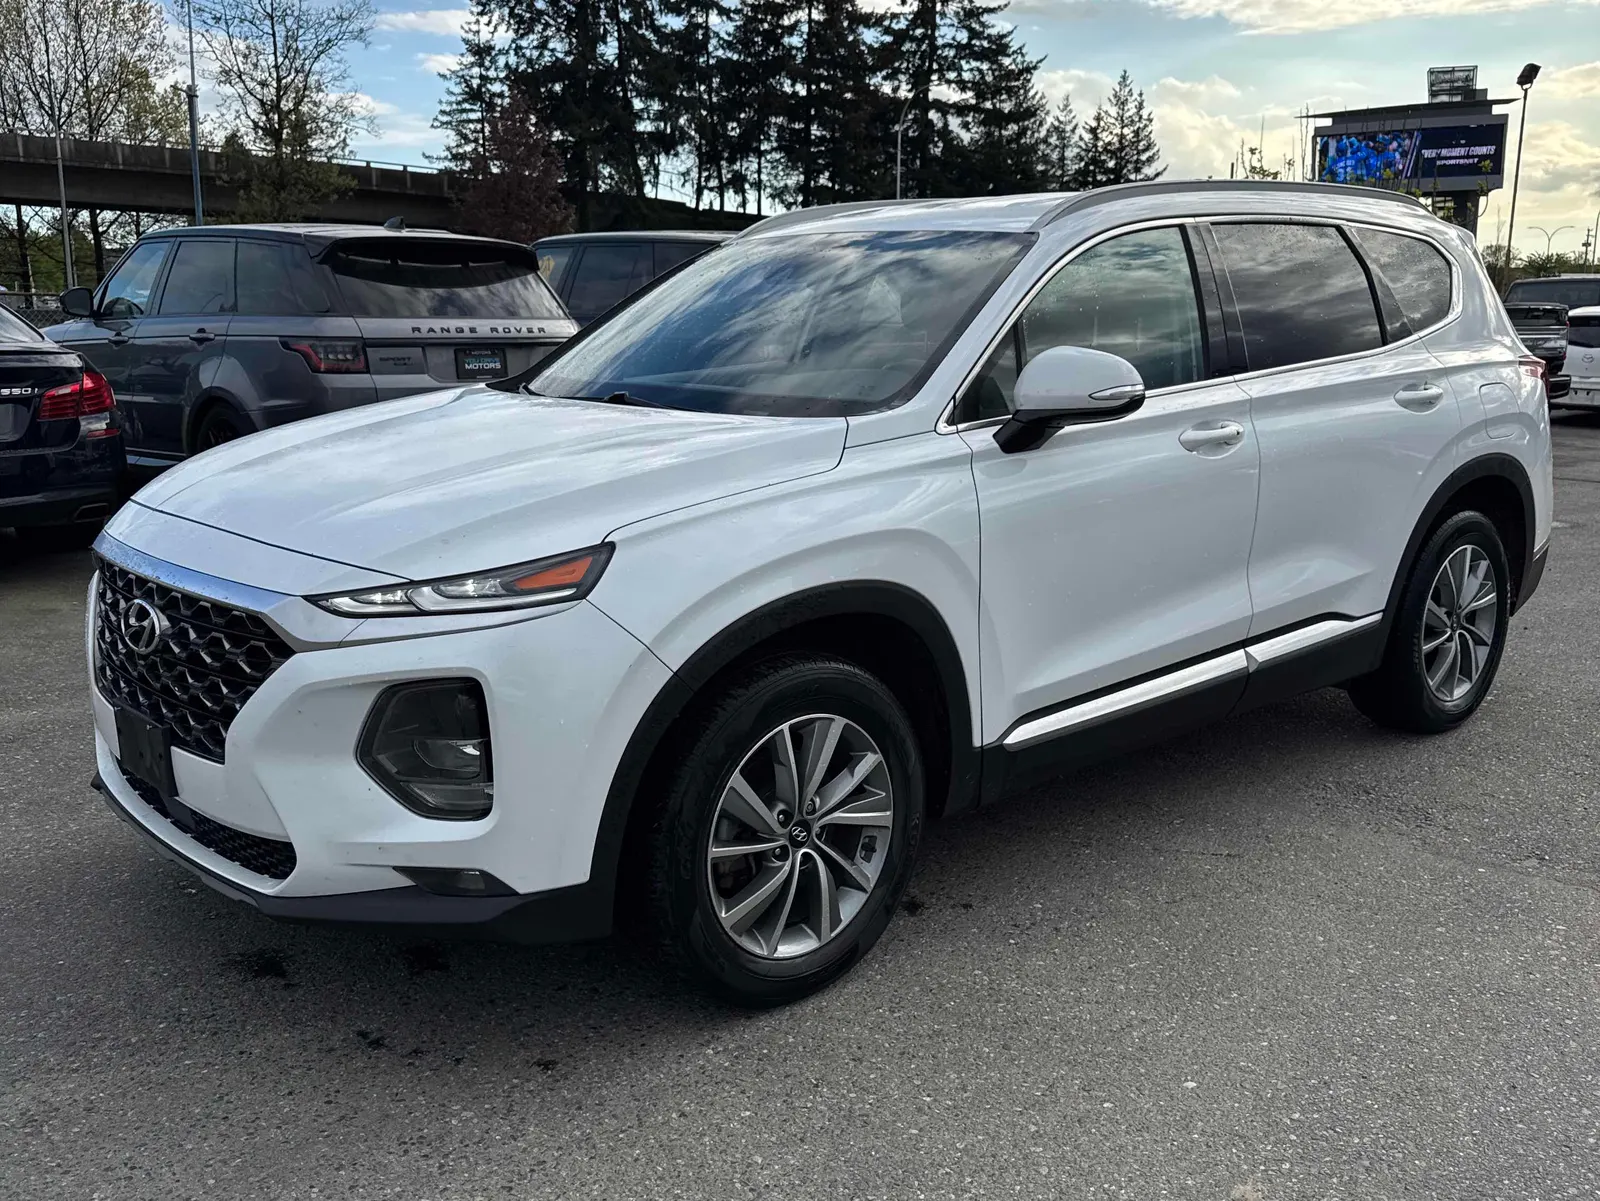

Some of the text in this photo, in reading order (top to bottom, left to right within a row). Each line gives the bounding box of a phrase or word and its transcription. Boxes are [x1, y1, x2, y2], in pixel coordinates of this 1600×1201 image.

[1440, 147, 1469, 157] MOMENT
[1468, 145, 1496, 156] COUNTS
[411, 326, 547, 334] RANGE ROVER
[464, 362, 502, 370] MOTORS
